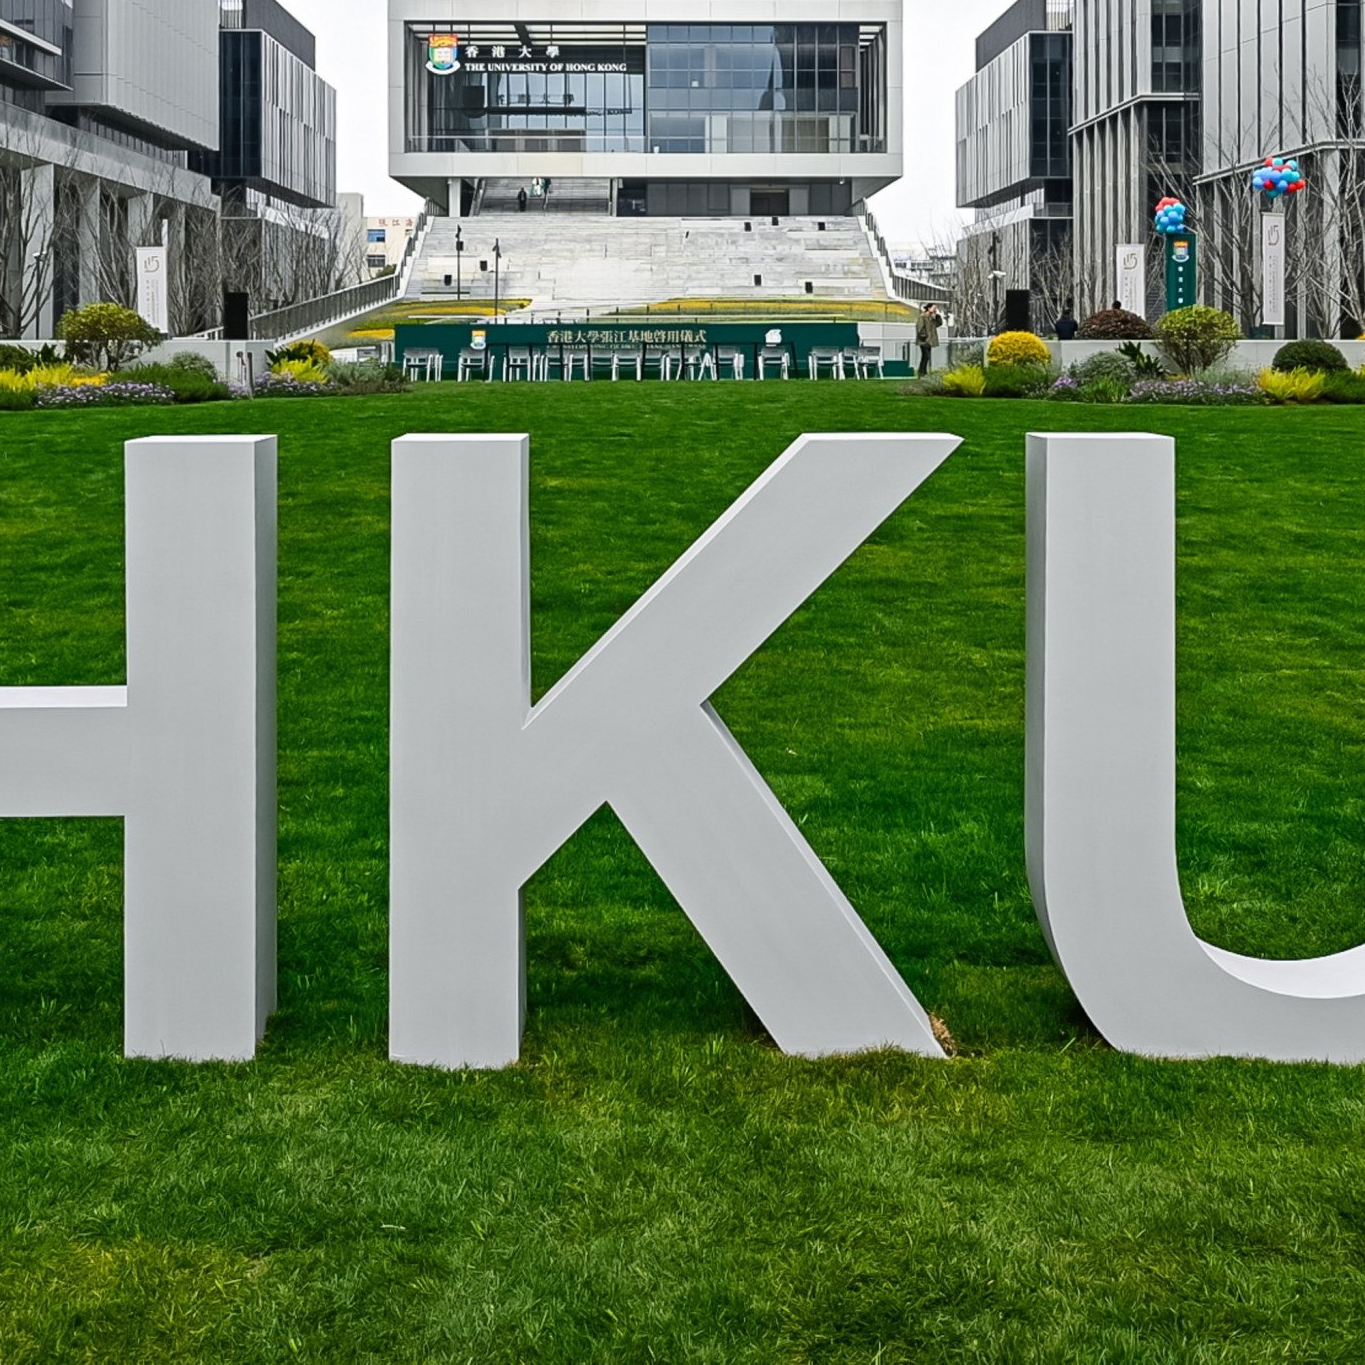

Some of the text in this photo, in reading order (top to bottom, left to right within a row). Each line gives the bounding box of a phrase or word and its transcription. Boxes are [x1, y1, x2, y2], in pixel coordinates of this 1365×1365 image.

[465, 45, 560, 59] 香港大學
[465, 62, 627, 72] THE UNIVERSITY OF HONG KONG
